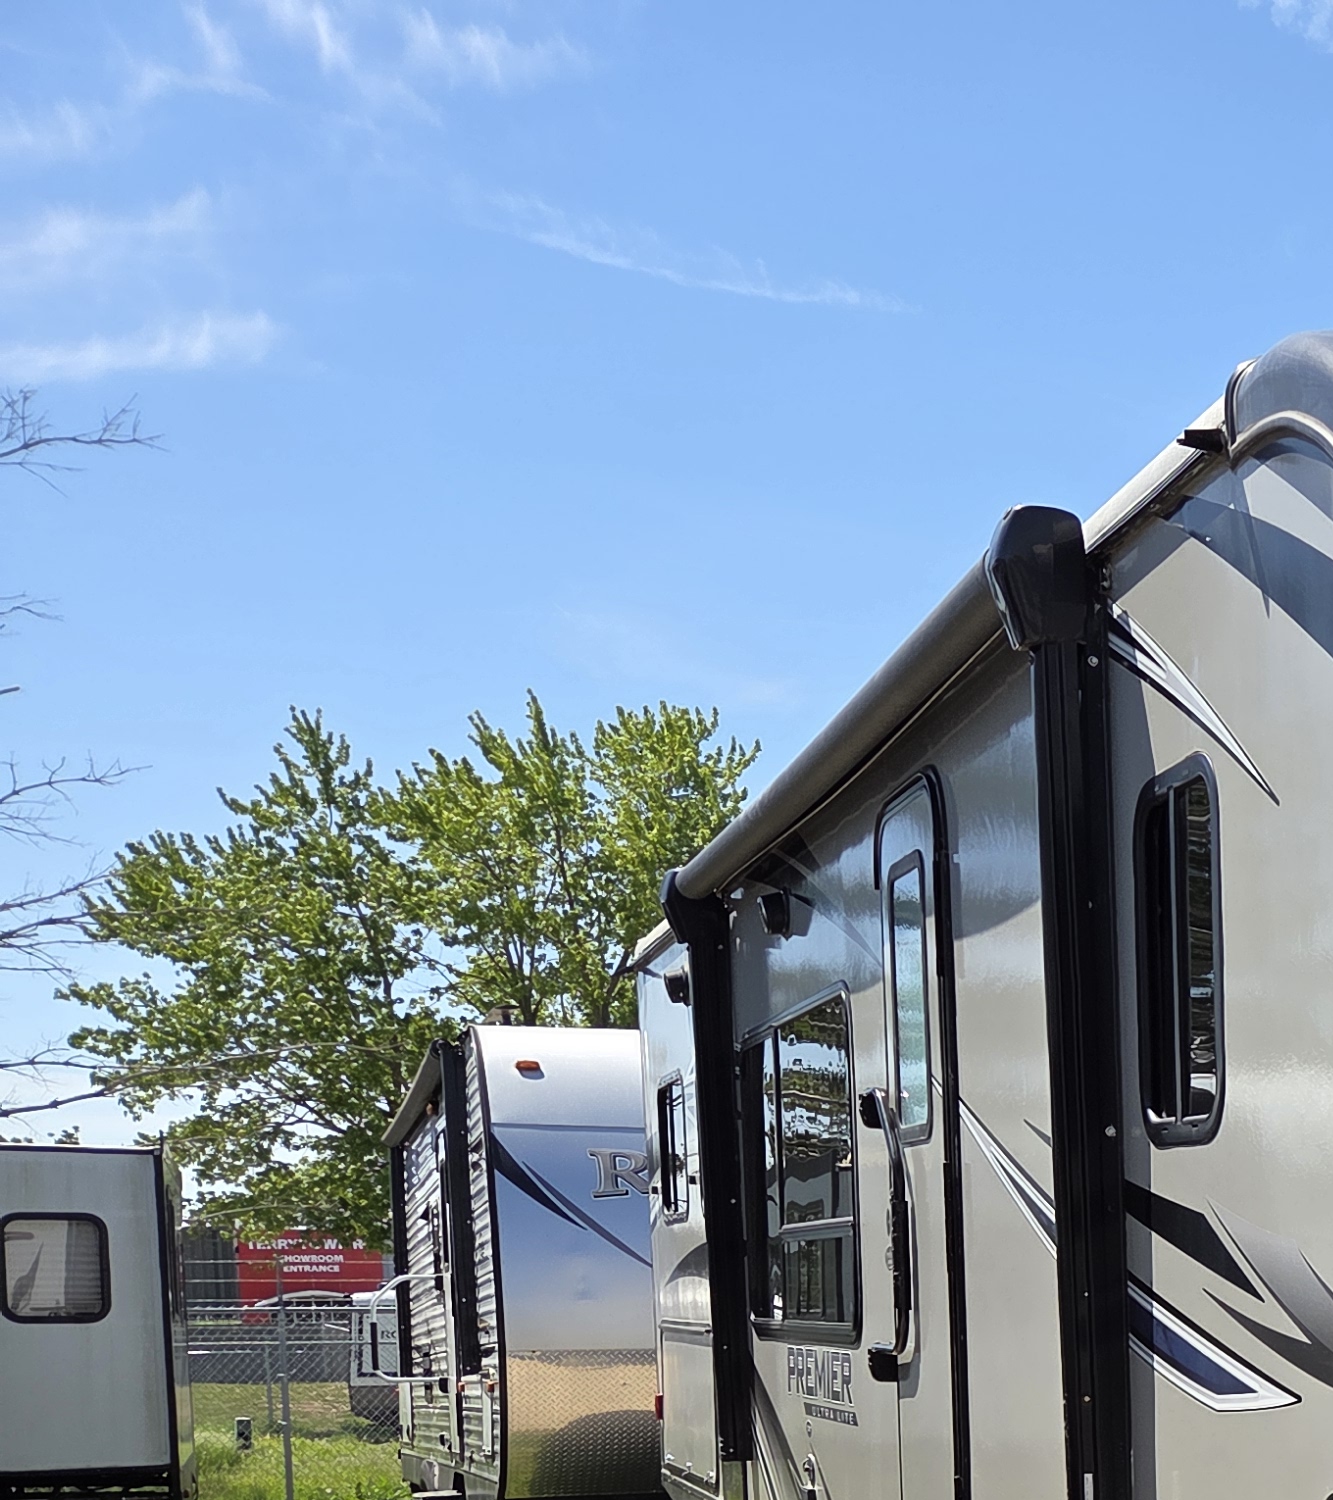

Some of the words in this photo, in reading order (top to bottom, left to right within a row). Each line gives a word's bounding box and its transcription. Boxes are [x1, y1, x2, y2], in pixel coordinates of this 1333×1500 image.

[283, 1265, 340, 1273] ENTRANCE
[787, 1345, 855, 1407] PREMIER
[811, 1406, 834, 1419] ULTRA
[836, 1411, 855, 1425] LITE
